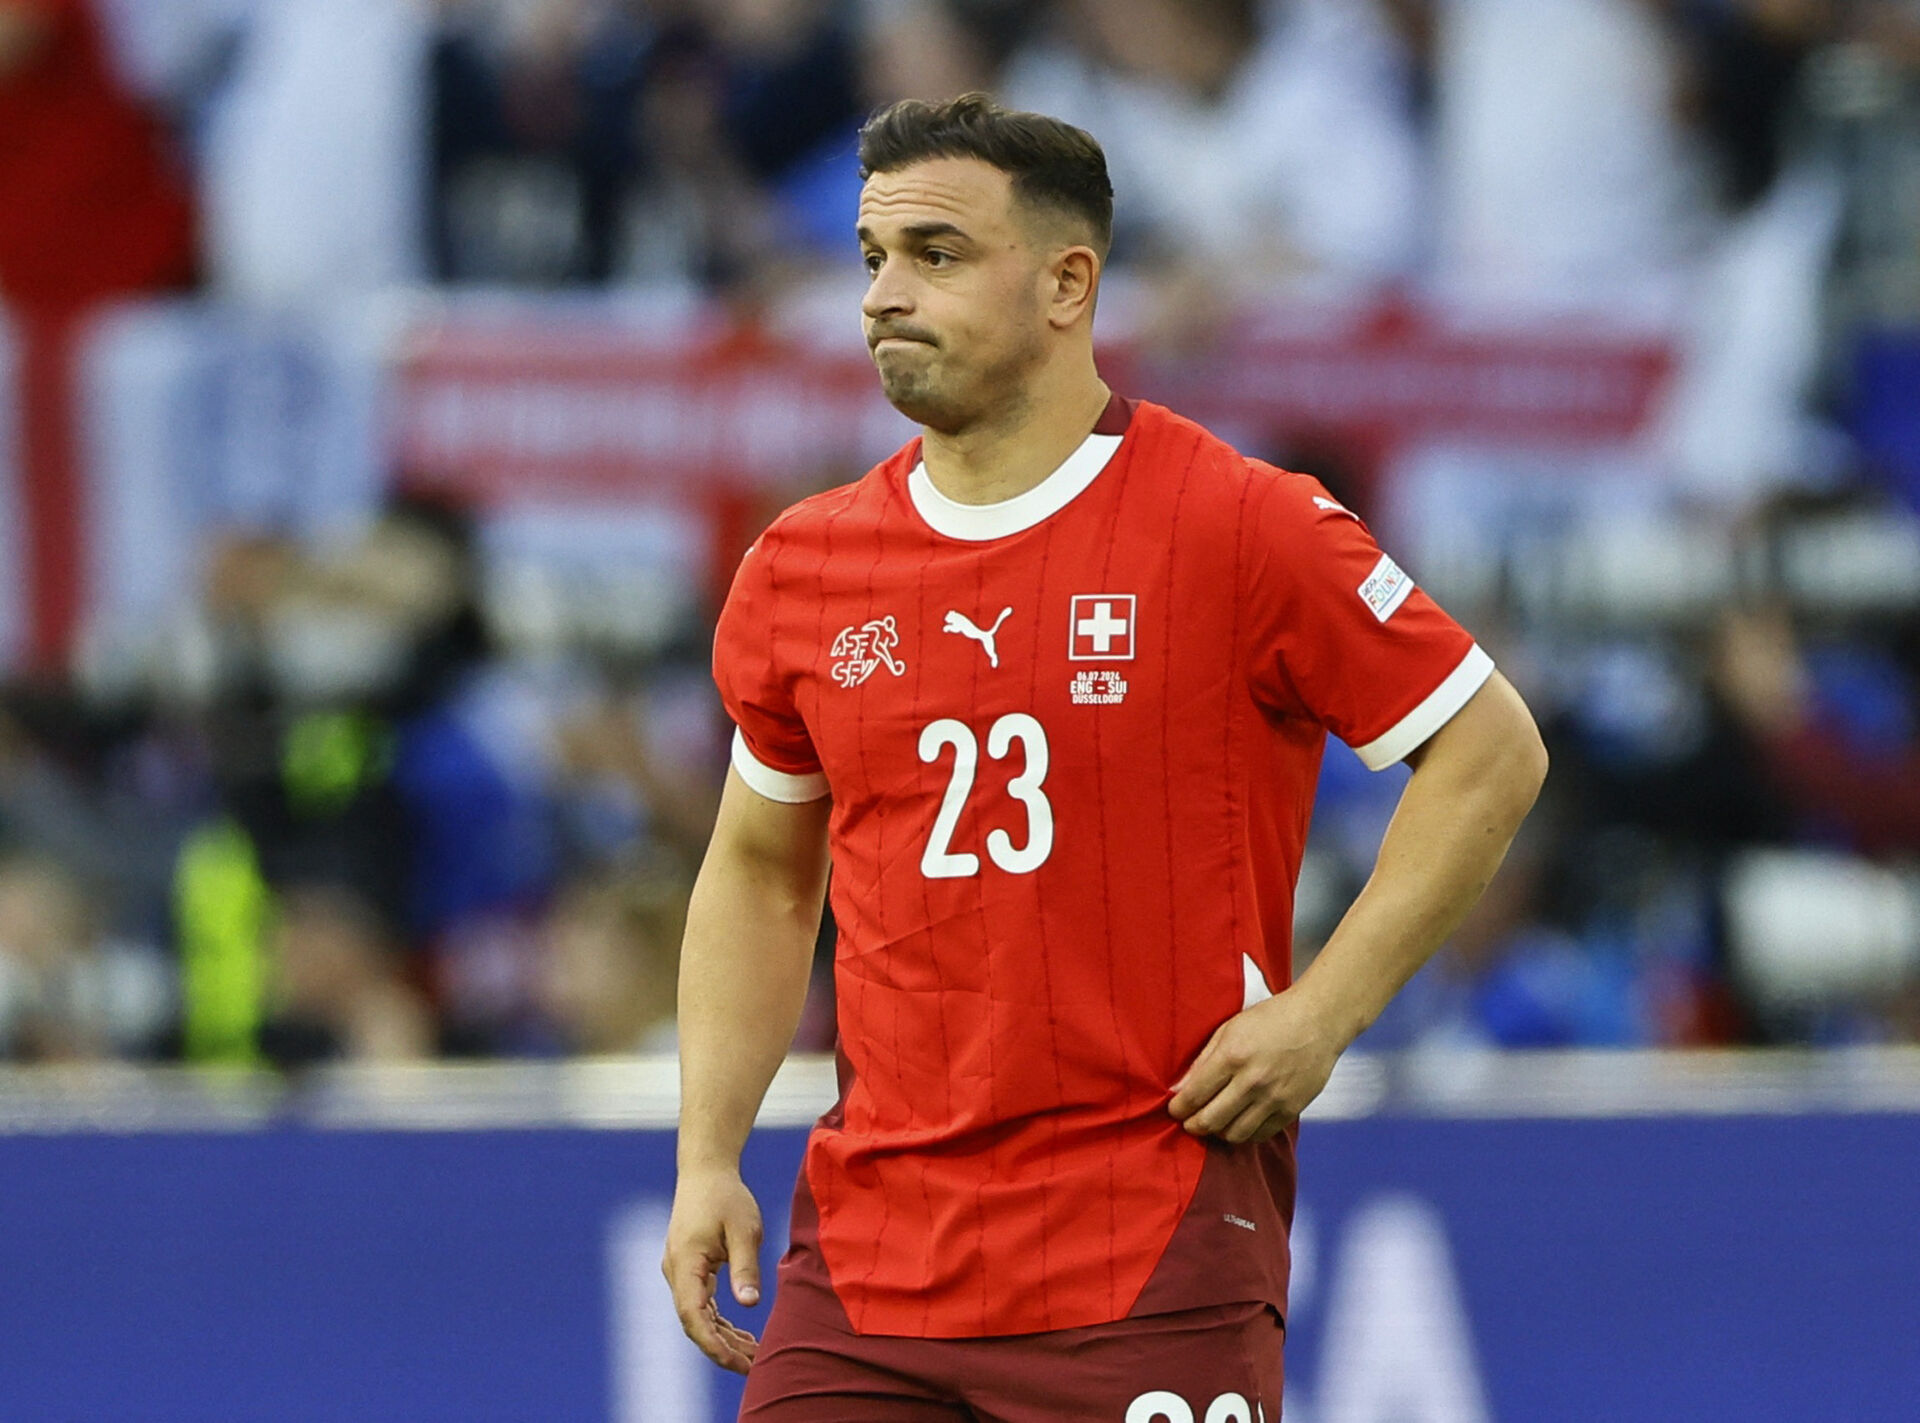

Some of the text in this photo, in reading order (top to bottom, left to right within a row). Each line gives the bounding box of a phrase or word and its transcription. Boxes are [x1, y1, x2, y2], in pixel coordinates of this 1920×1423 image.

[1070, 680, 1093, 694] ENG
[1107, 680, 1127, 694] SUI
[918, 712, 1054, 879] 23
